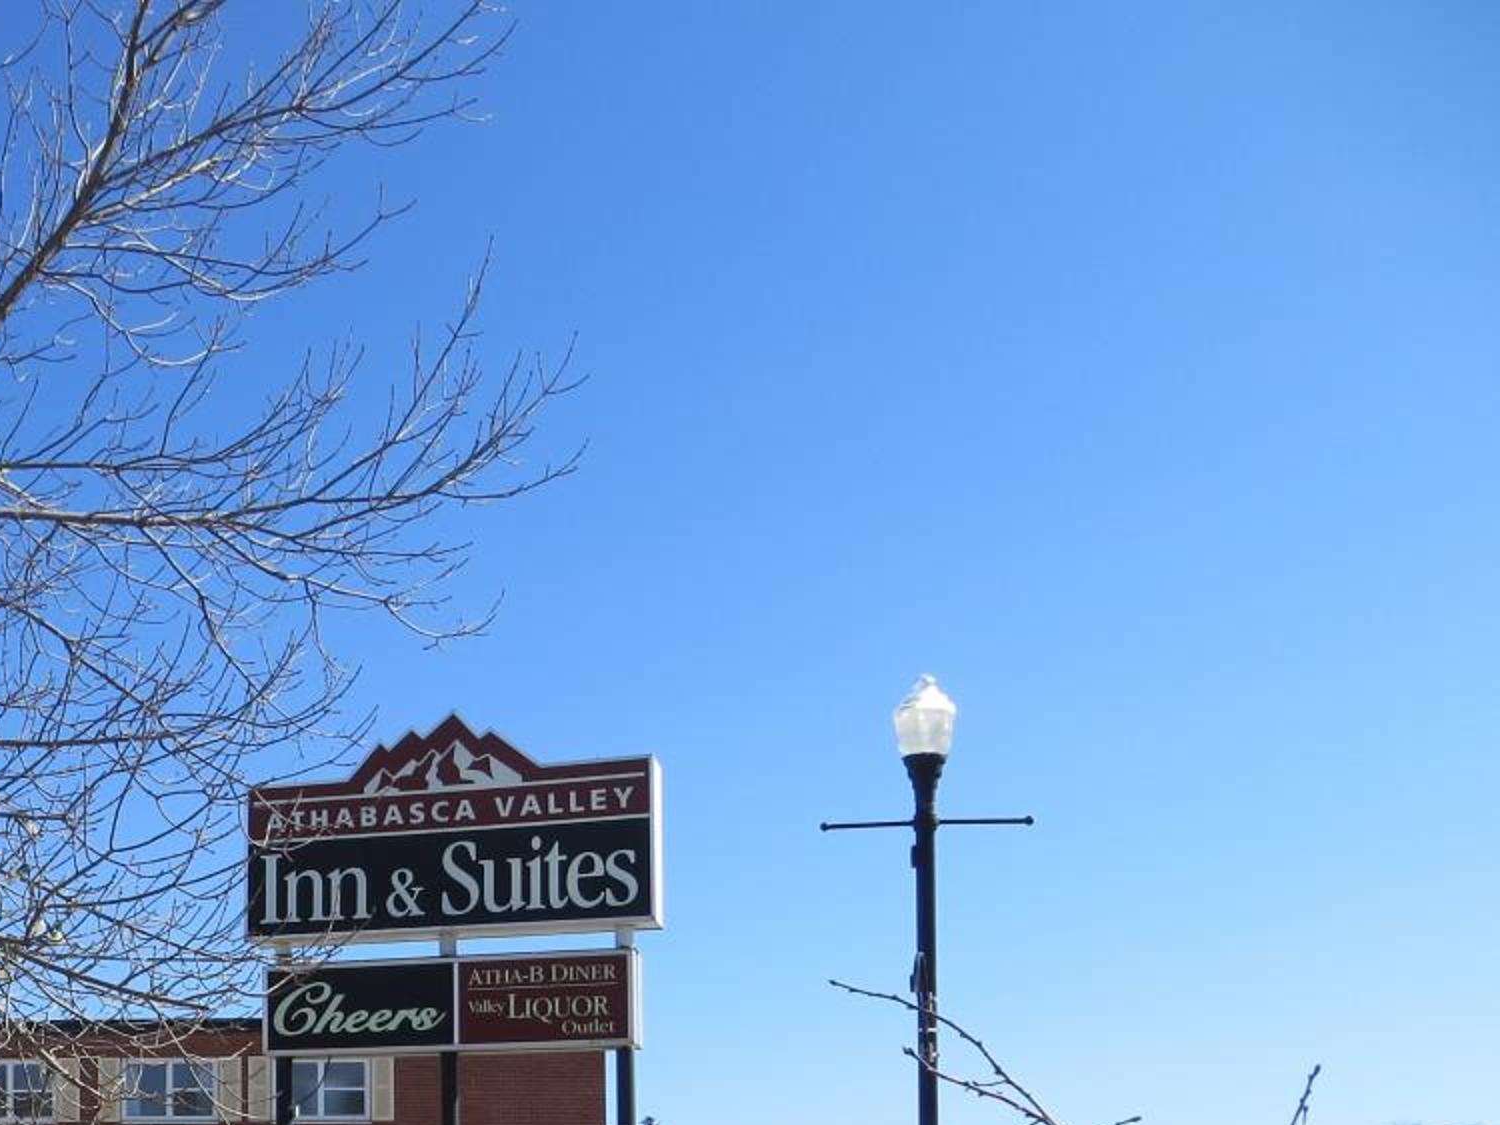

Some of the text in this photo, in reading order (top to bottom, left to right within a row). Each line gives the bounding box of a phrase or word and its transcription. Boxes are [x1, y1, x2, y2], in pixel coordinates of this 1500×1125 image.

[266, 786, 634, 834] ATHABASCA VALLEY
[260, 835, 639, 925] Inn & Suites
[468, 963, 616, 985] ATHA-B DINER
[273, 981, 446, 1036] Cheers
[468, 993, 609, 1023] Valley LIQUOR
[561, 1019, 614, 1034] Outlet
